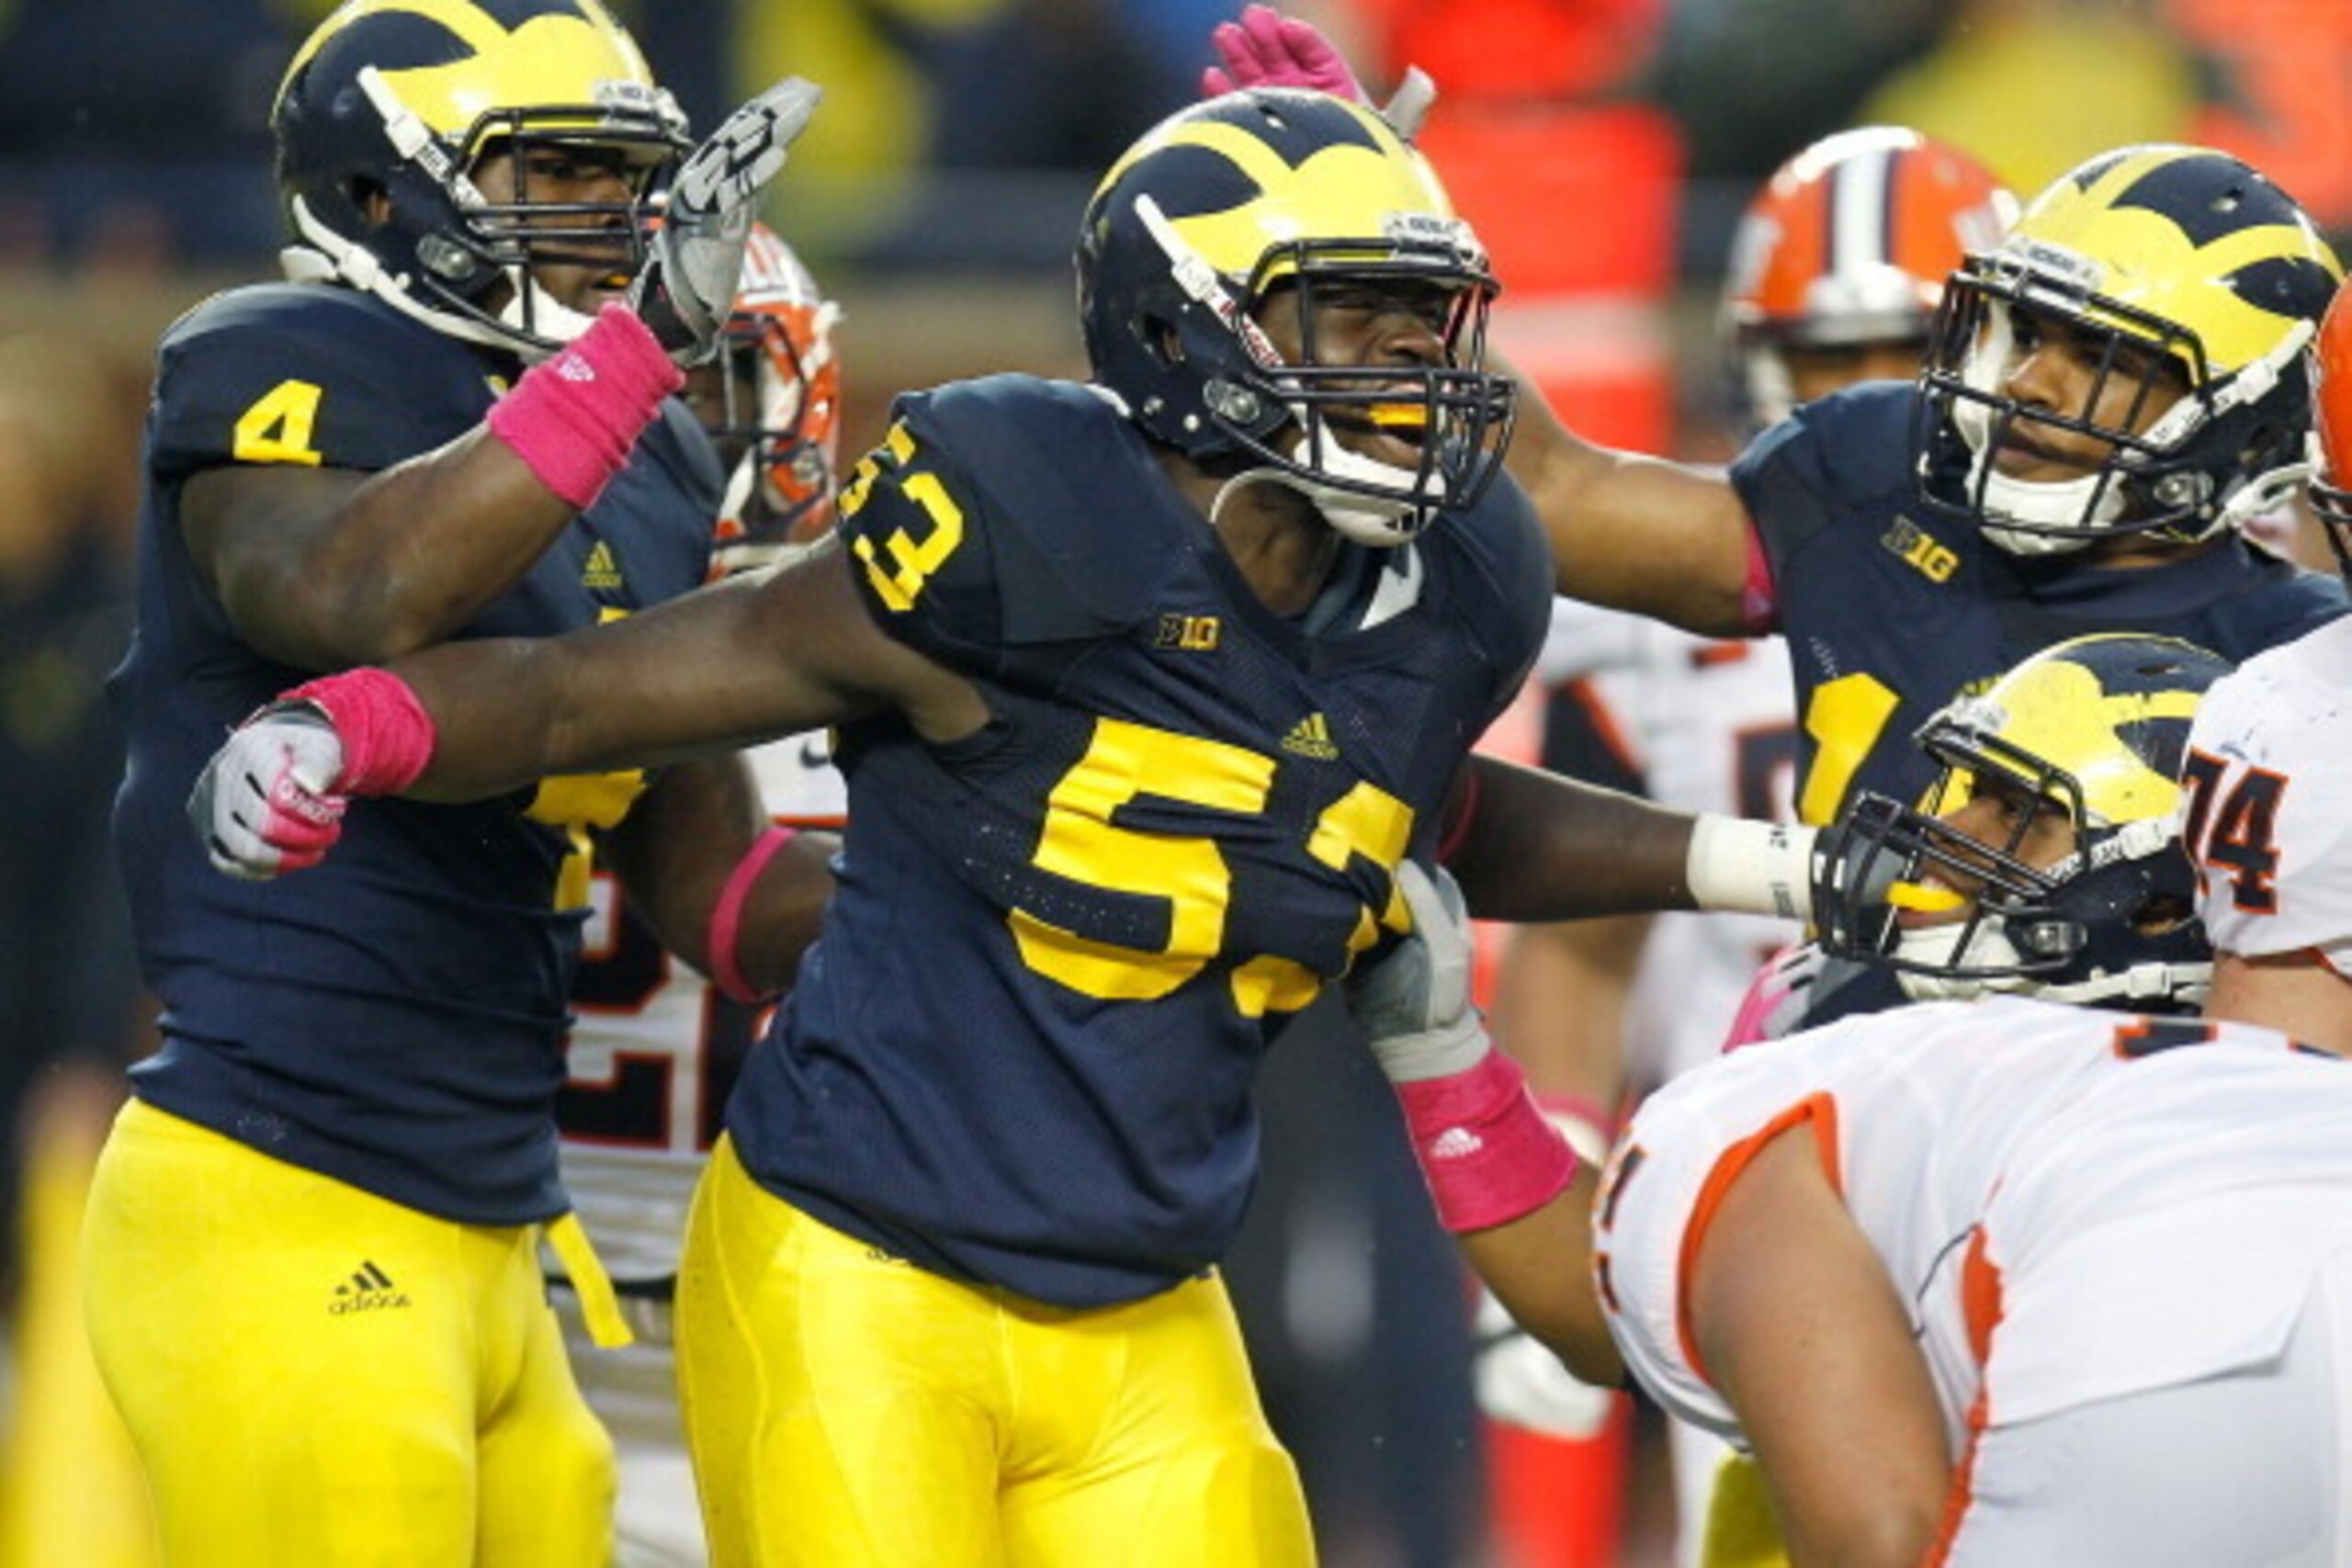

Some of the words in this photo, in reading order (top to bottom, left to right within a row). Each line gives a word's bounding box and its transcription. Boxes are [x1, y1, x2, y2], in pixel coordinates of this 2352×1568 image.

[233, 378, 322, 467] 4
[1007, 716, 1415, 1019] 53
[2181, 745, 2290, 916] 74
